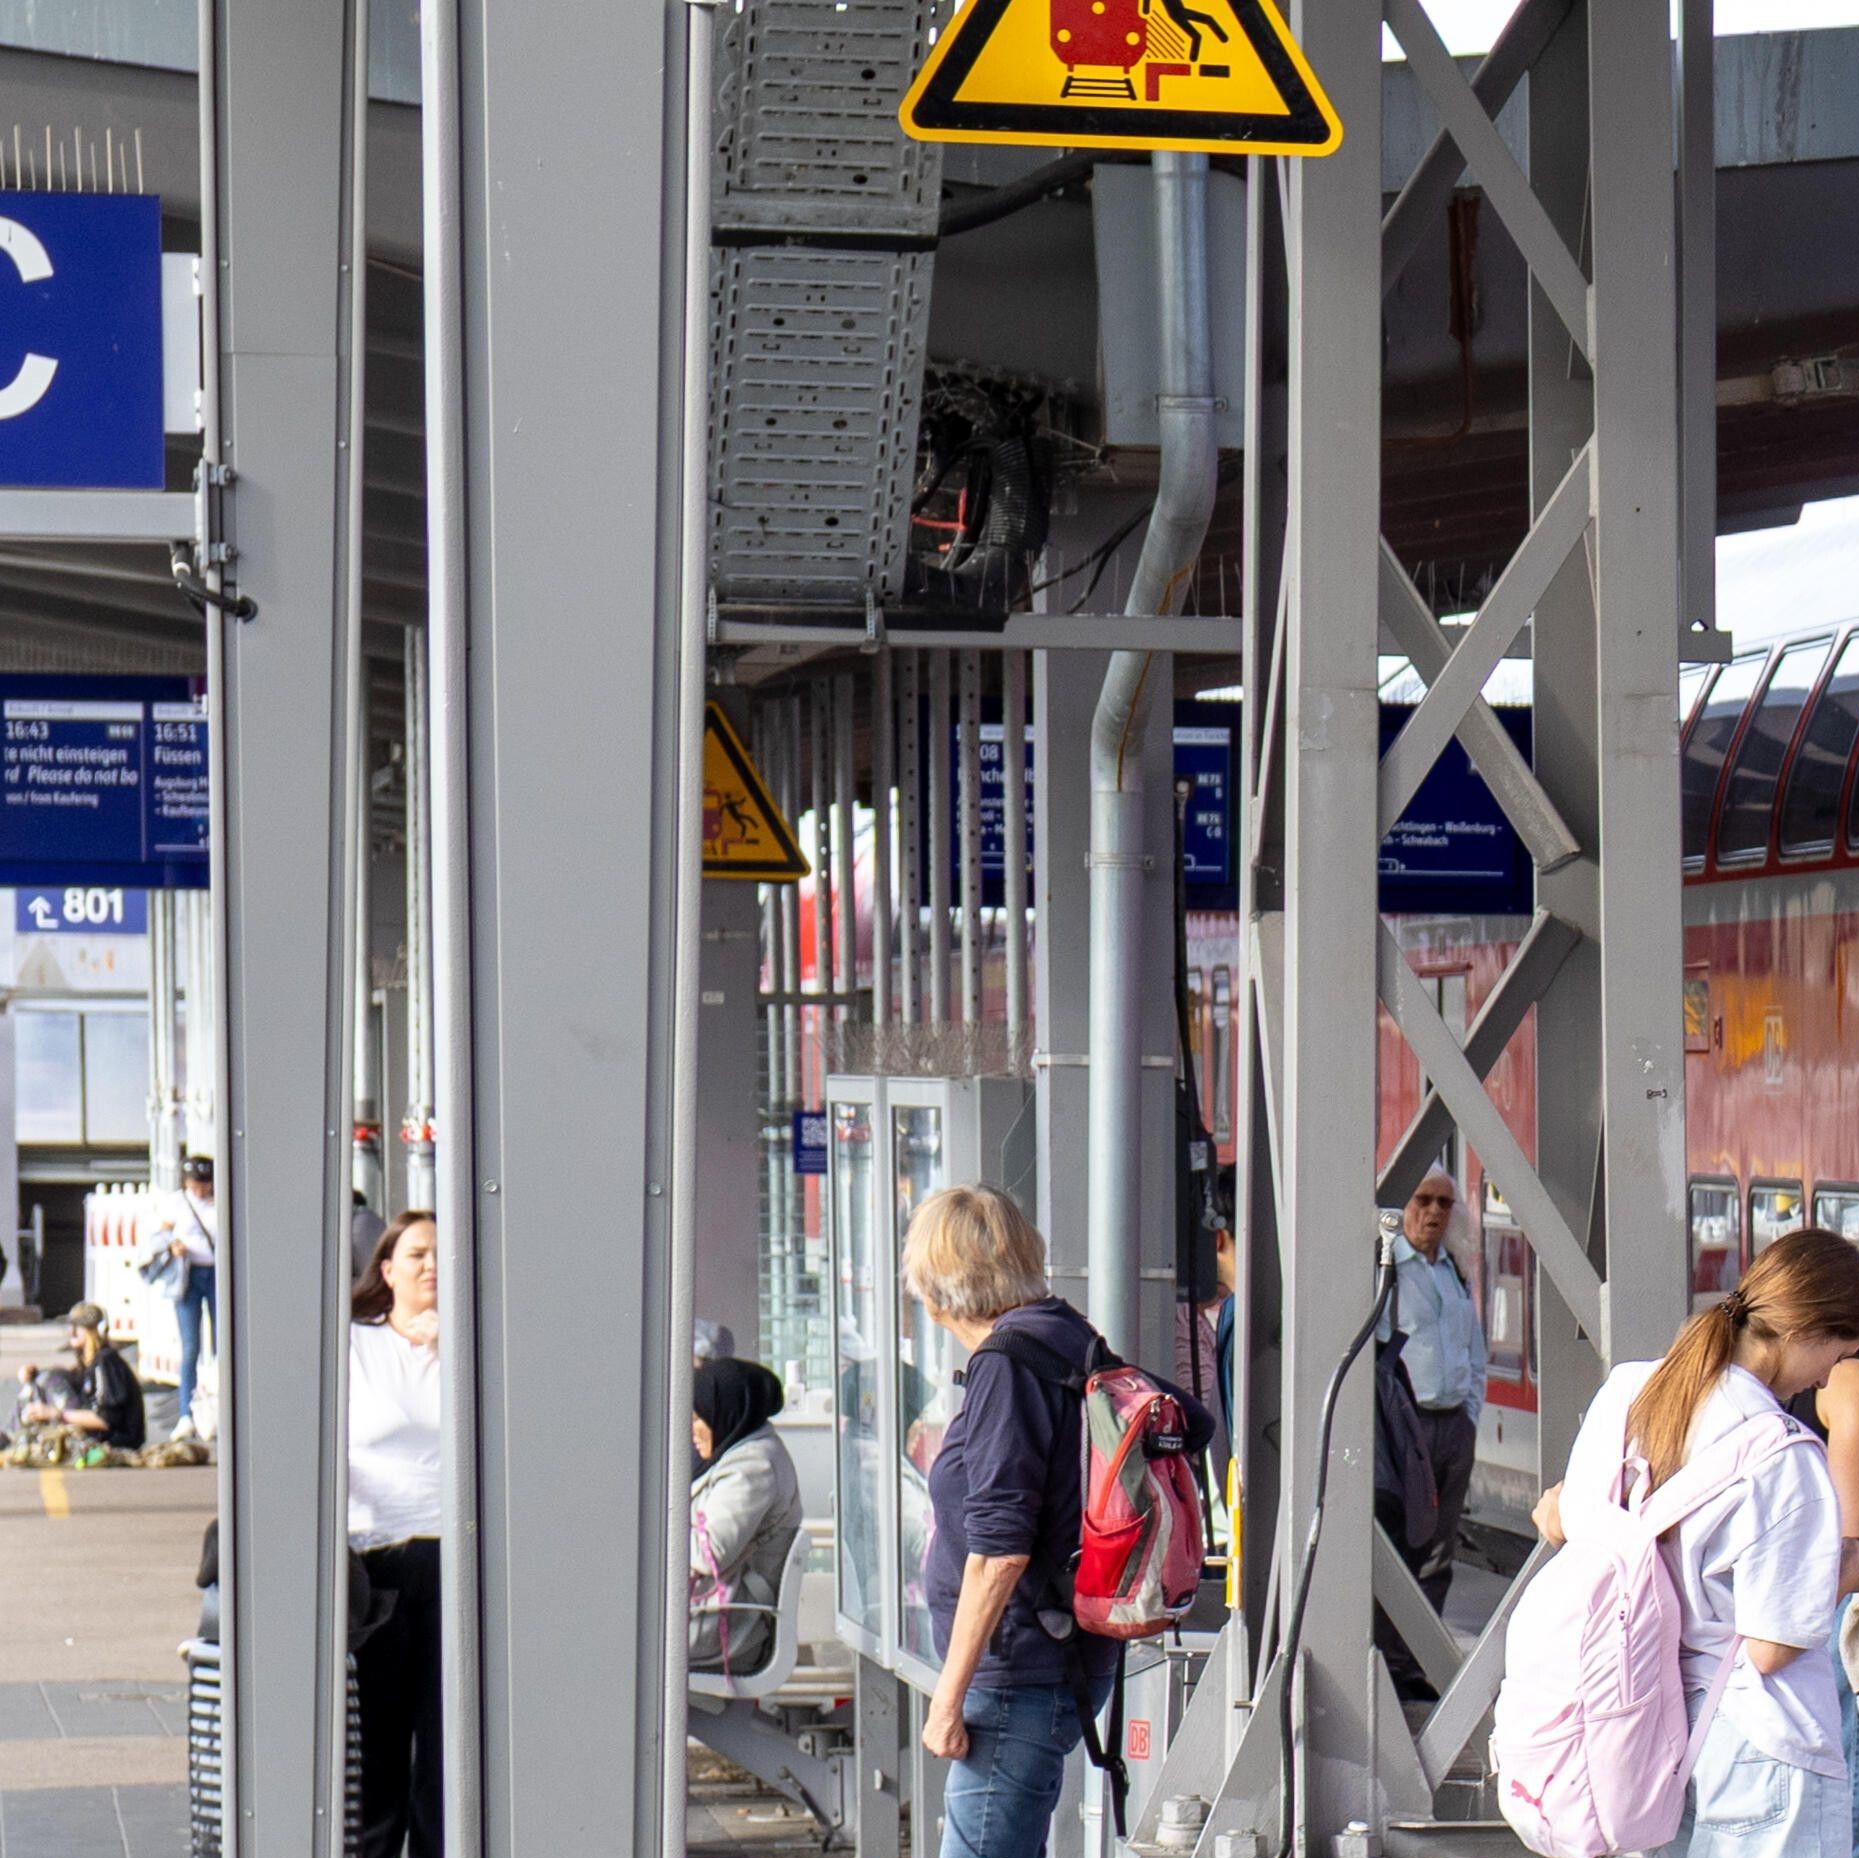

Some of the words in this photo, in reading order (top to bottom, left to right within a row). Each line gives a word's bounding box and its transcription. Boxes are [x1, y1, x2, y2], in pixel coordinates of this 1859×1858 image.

[56, 745, 128, 767] einsteigen
[154, 746, 201, 765] Füssen
[28, 765, 73, 784] Please
[74, 766, 92, 785] do
[94, 768, 118, 784] not
[62, 886, 124, 924] 801
